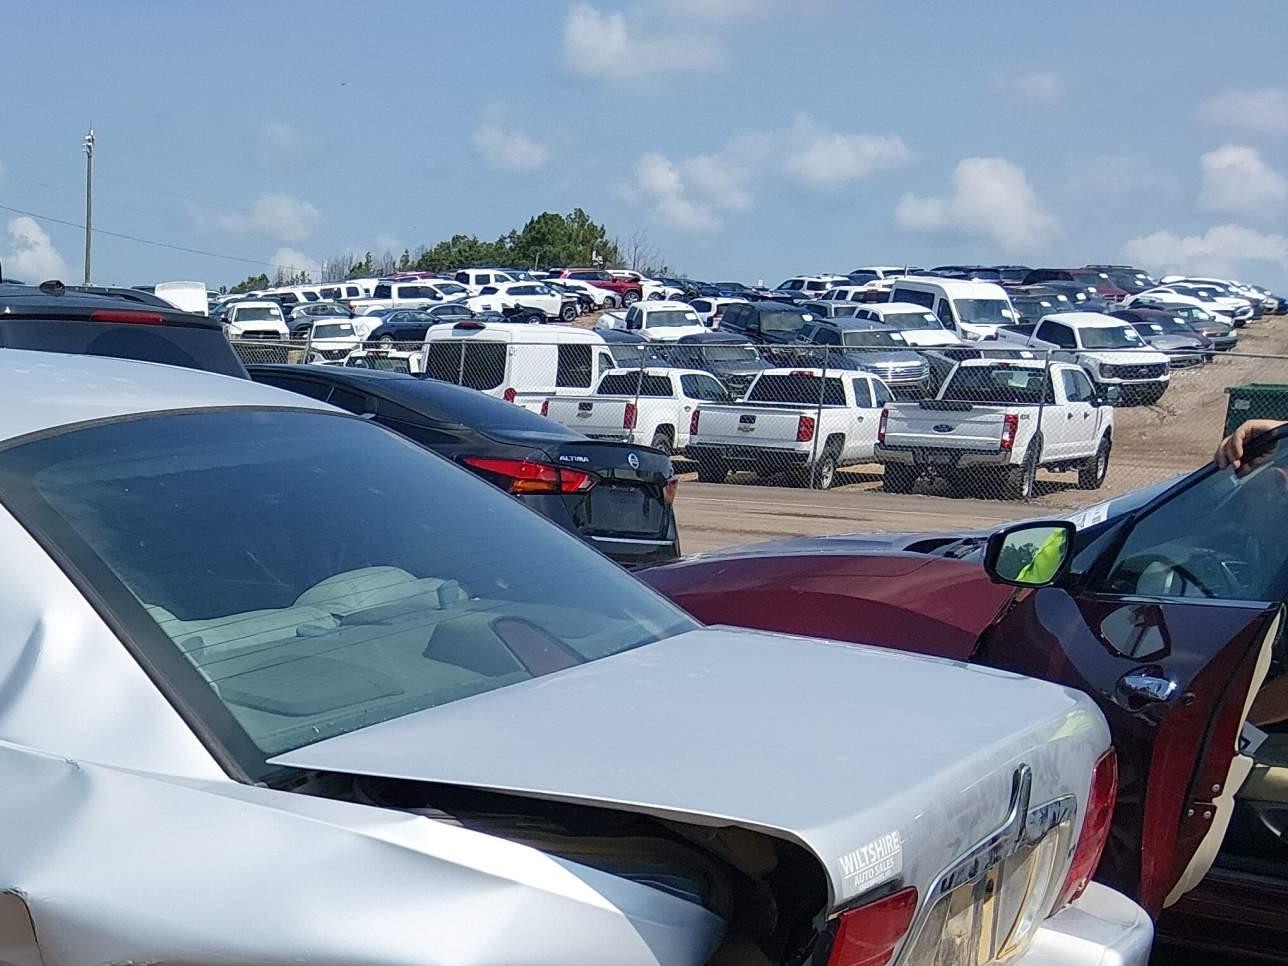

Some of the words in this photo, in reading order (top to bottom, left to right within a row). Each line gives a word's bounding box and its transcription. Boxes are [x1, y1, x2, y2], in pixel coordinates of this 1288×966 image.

[840, 830, 900, 875] WILTSHIRE
[854, 868, 874, 887] AUTO
[874, 858, 895, 876] SALES
